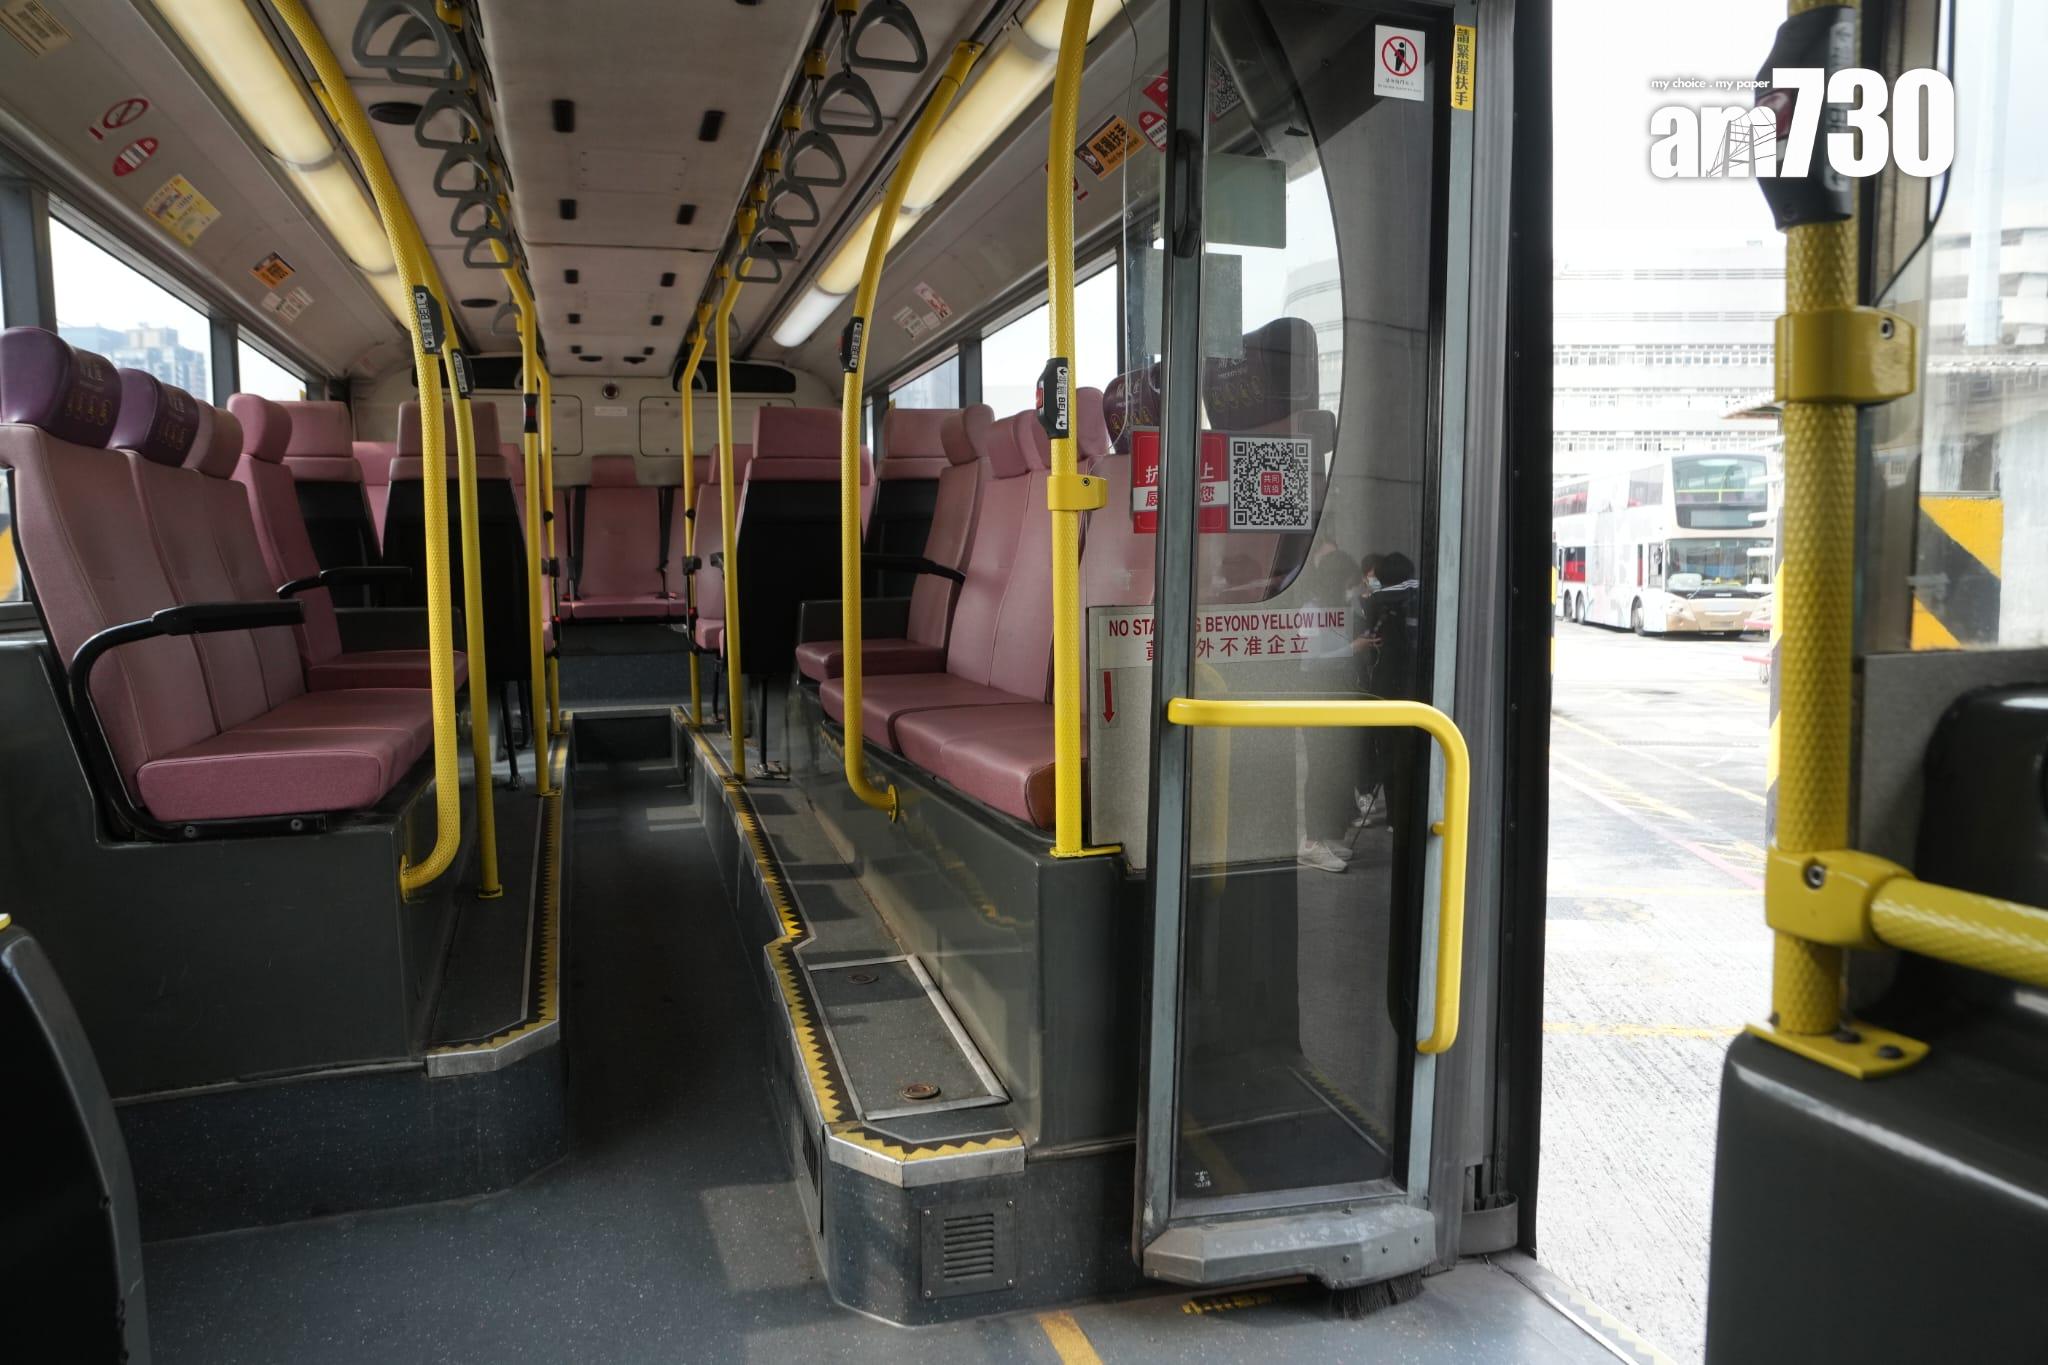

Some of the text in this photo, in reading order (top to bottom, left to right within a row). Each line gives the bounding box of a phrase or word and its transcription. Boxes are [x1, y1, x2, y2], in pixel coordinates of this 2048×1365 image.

[1455, 28, 1470, 106] 請緊握扶手
[1057, 397, 1066, 419] BELL
[1109, 620, 1129, 637] NO
[1205, 614, 1260, 632] BEYOND
[1262, 612, 1315, 630] YELLOW
[1317, 611, 1345, 628] LINE
